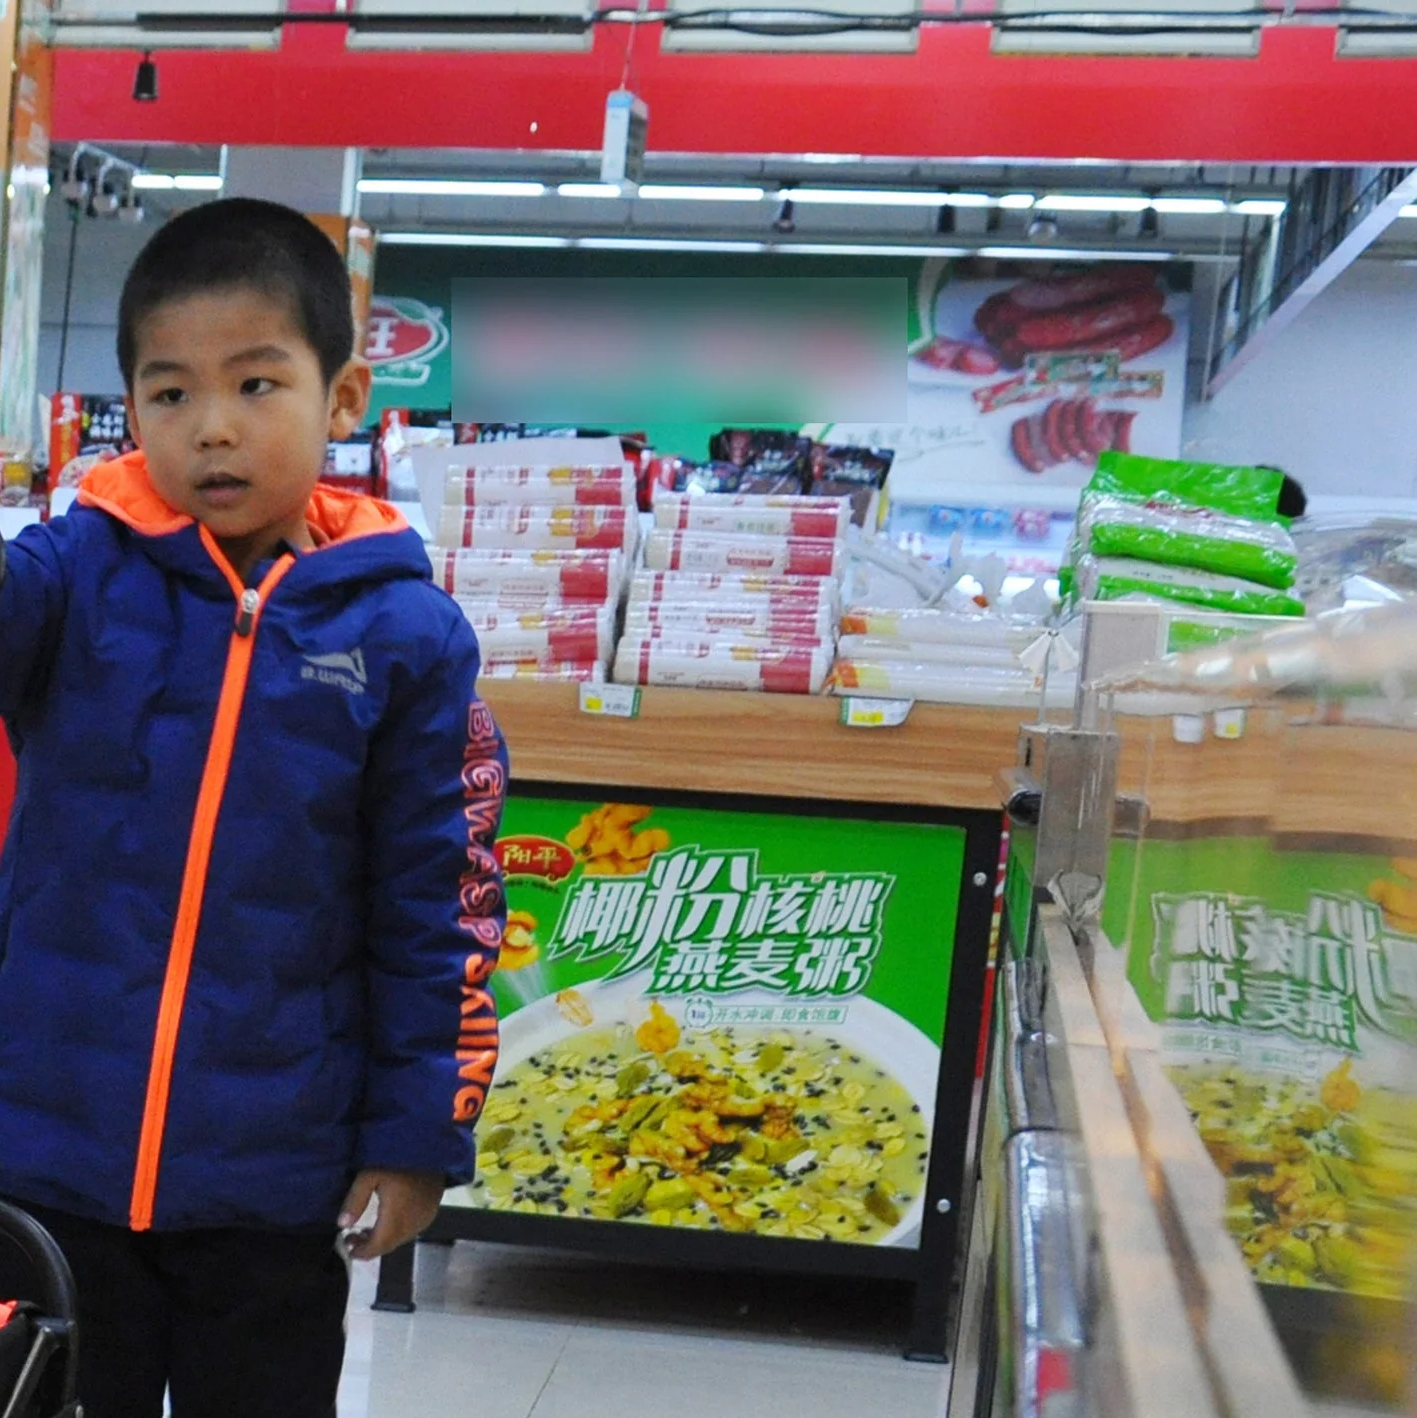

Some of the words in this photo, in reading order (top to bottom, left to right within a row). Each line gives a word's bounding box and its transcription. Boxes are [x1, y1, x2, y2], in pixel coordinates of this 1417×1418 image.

[459, 701, 505, 947] BIGWASP
[503, 844, 561, 871] 阳平
[560, 852, 883, 970] 椰粉核桃
[655, 938, 872, 990] 燕麦粥
[453, 953, 499, 1120] SKIING
